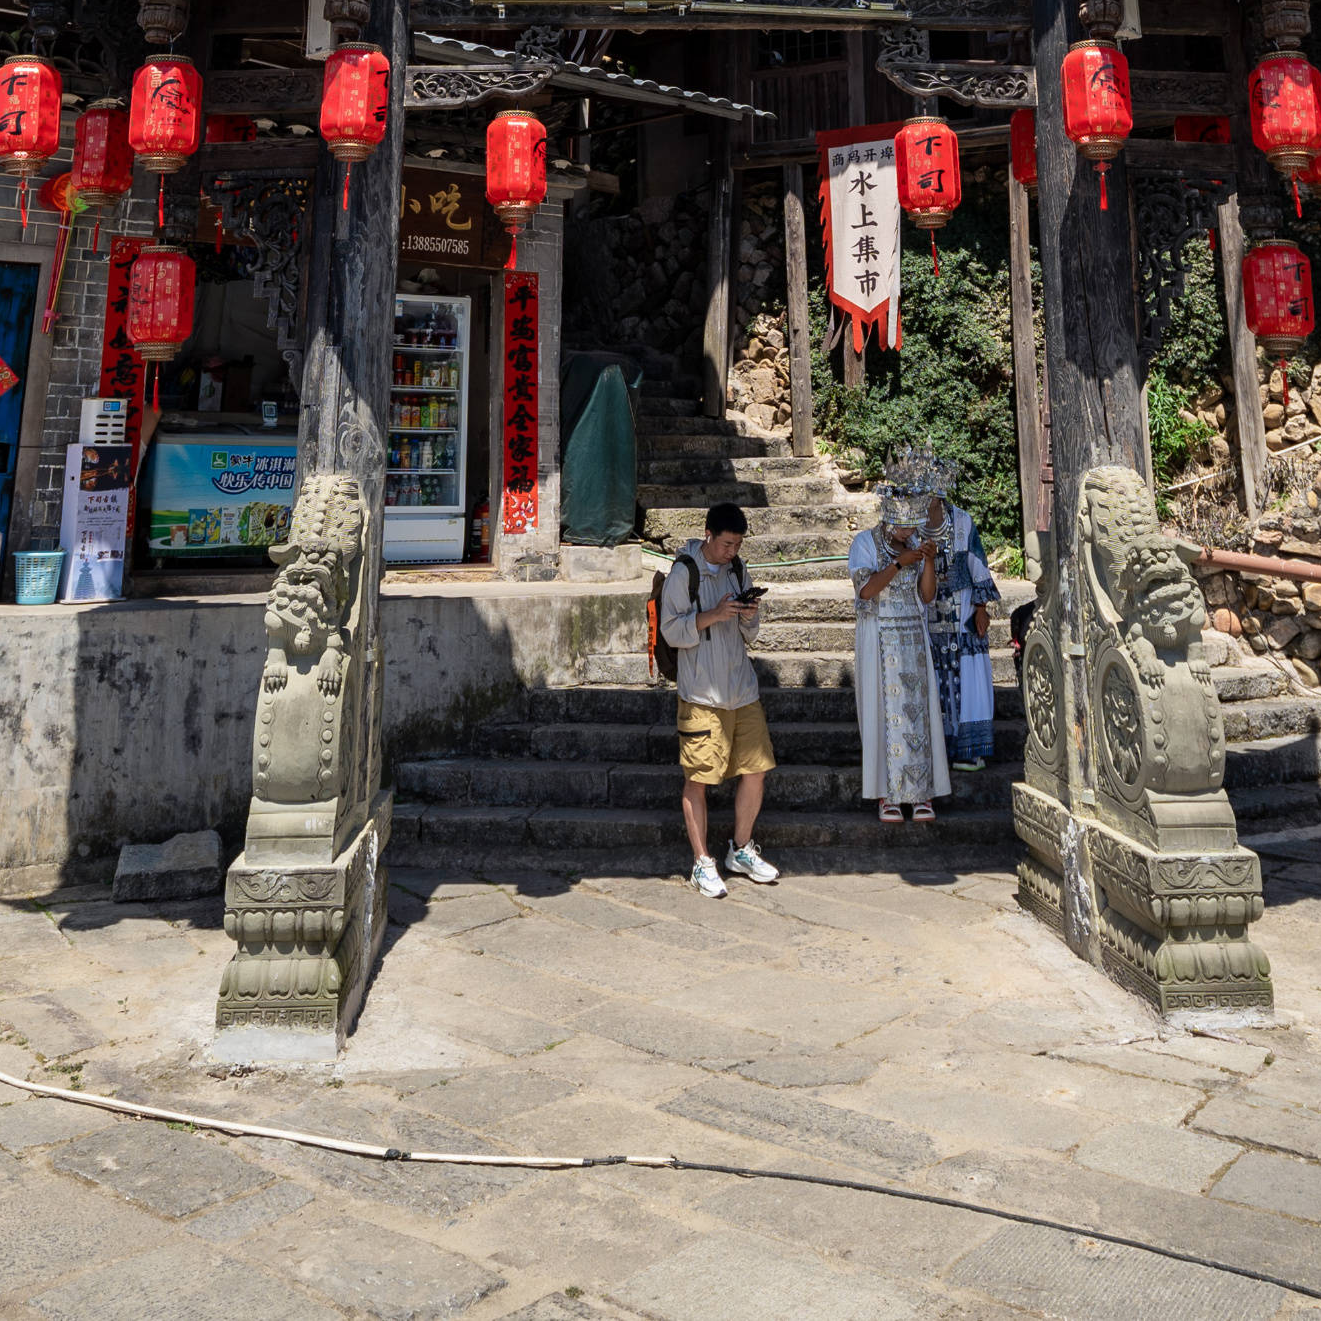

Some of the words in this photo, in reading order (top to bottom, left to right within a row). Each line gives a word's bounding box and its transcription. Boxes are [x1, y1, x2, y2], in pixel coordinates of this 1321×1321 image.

[915, 135, 945, 193] 下司
[848, 170, 881, 298] 水上集市
